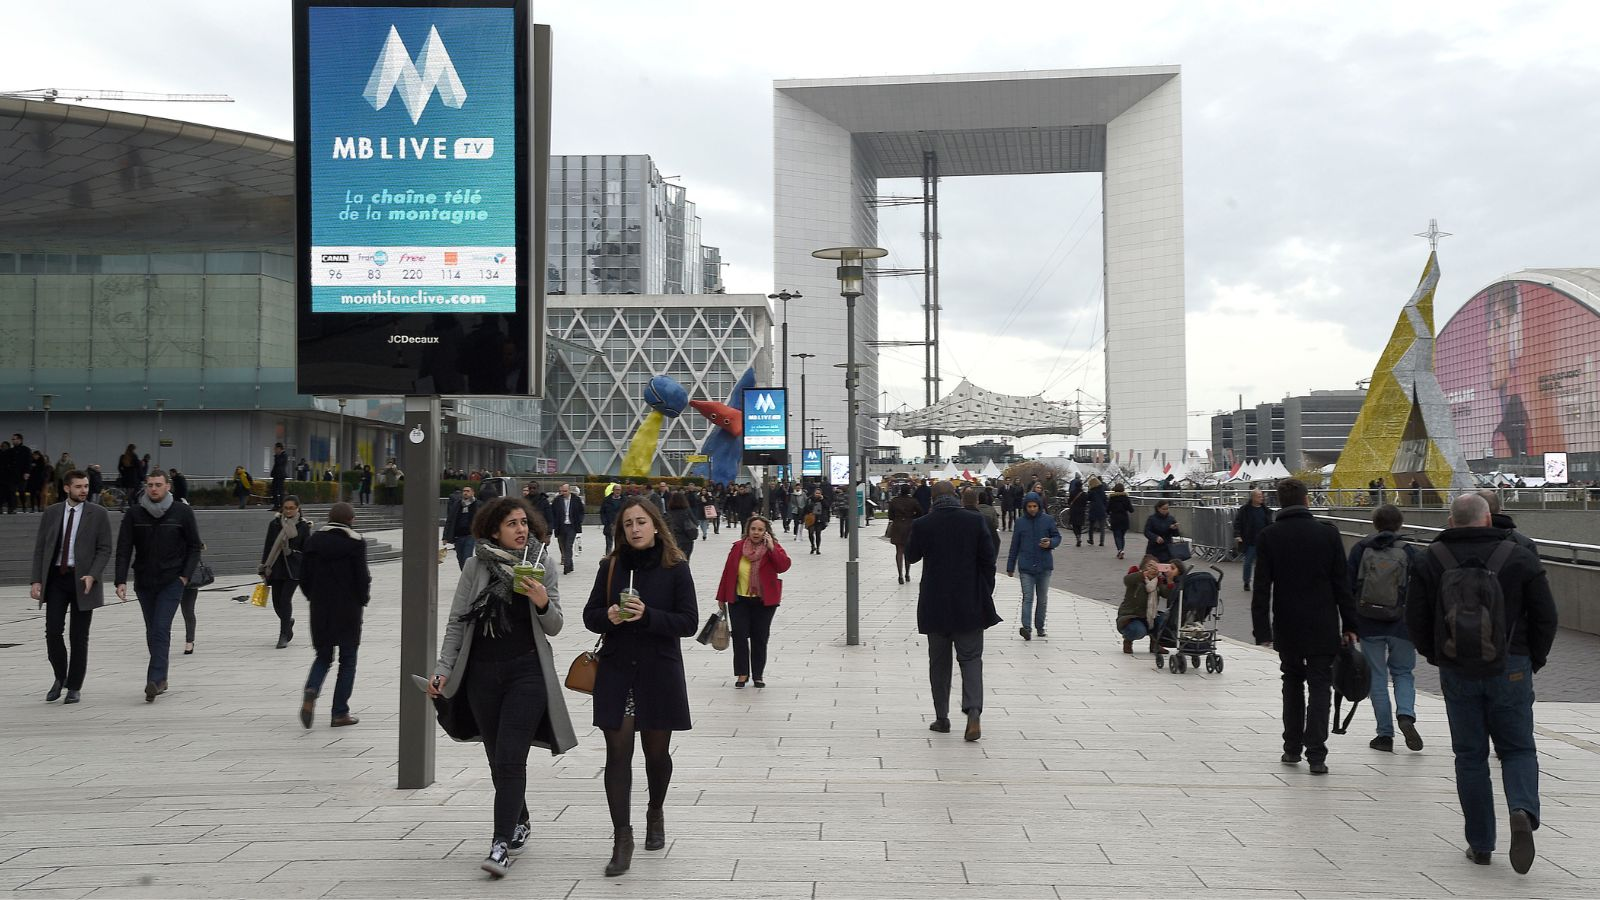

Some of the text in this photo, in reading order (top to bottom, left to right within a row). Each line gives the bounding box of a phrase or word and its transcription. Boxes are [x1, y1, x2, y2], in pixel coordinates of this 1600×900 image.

[463, 143, 485, 154] TV
[345, 189, 482, 204] La chaîne télé
[339, 205, 489, 224] de la montagne
[322, 254, 349, 263] CANAL
[329, 270, 343, 280] 96
[367, 270, 382, 280] 83
[402, 270, 423, 280] 220
[441, 270, 461, 280] 114
[479, 270, 500, 280] 134
[341, 290, 486, 305] montblanclive.com
[387, 335, 440, 344] JCDecaux
